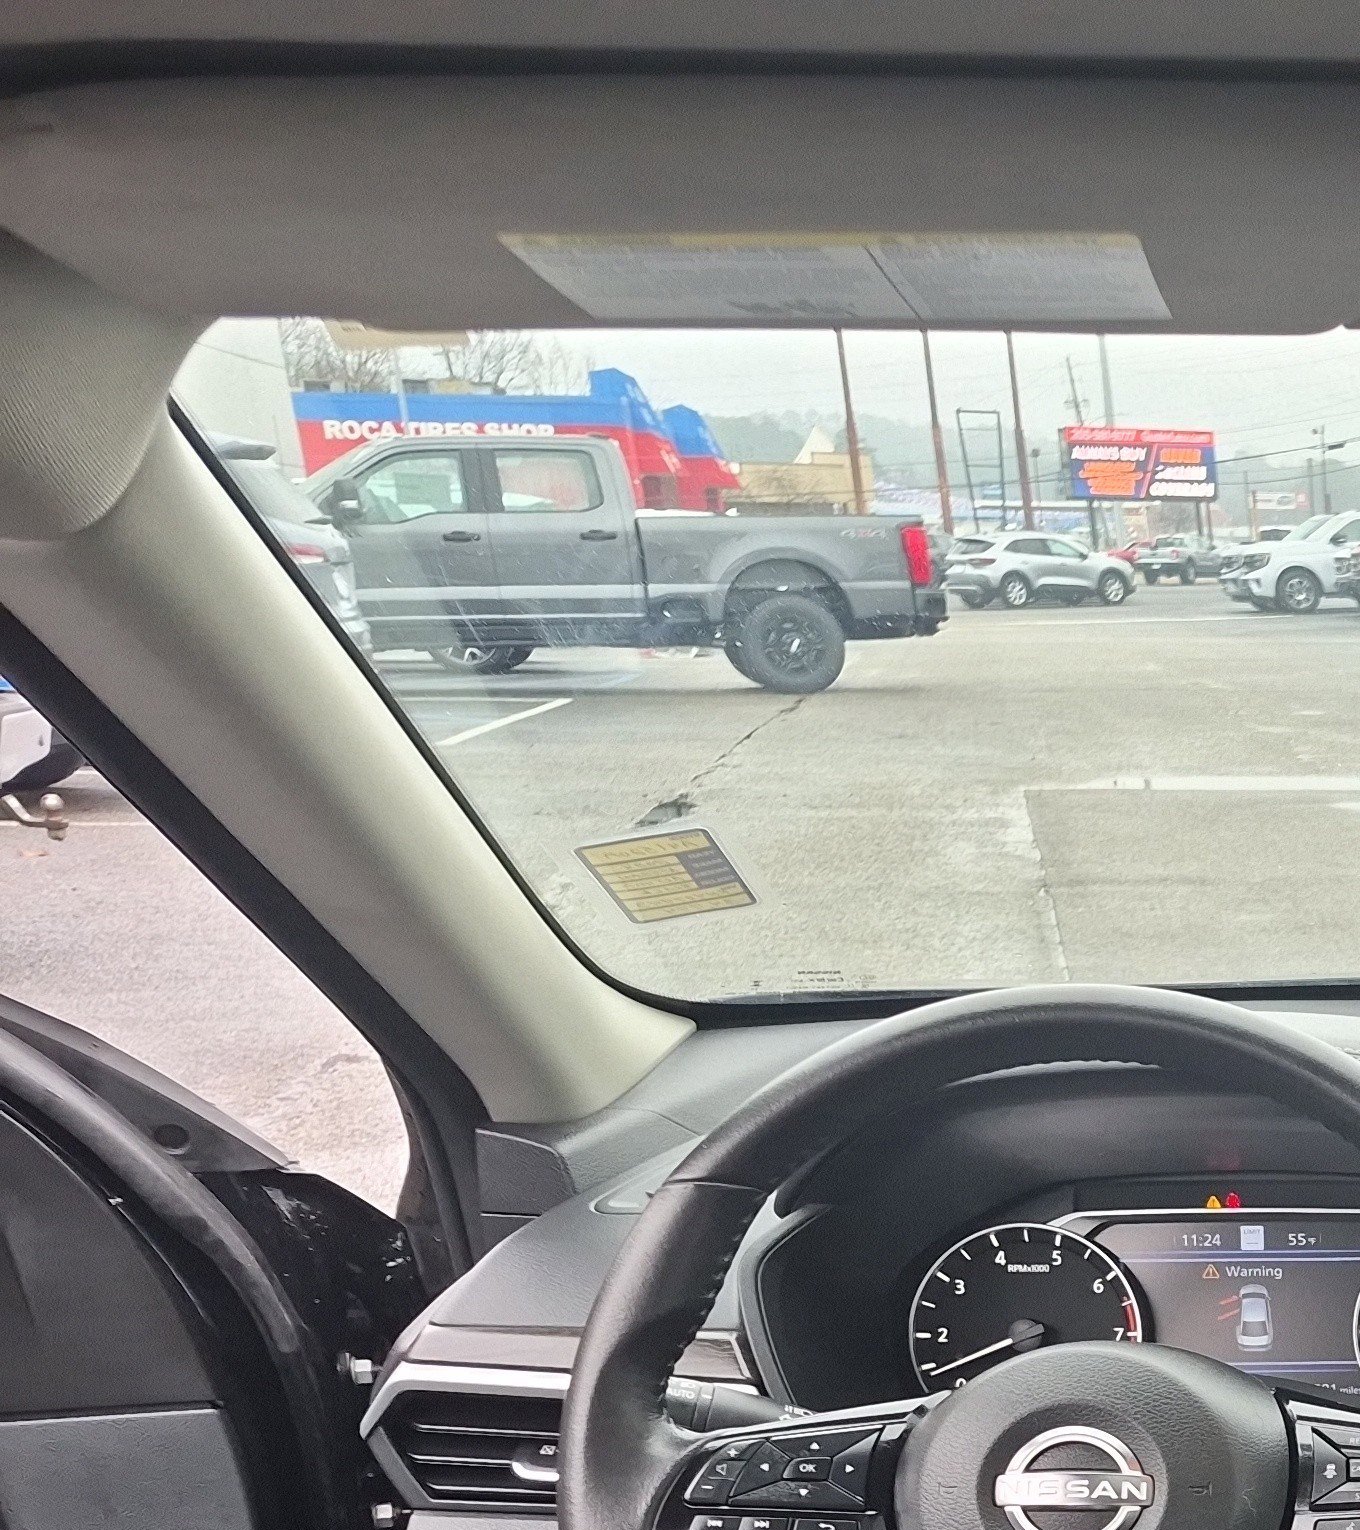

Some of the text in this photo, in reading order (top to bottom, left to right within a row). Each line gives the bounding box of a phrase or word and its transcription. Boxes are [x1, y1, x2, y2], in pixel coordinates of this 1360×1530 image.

[322, 420, 399, 439] ROCA
[1182, 1233, 1222, 1247] 11:24
[995, 1250, 1007, 1266] 4
[1051, 1250, 1062, 1266] 5
[1226, 1266, 1283, 1279] Warning
[954, 1279, 966, 1294] 3
[1093, 1278, 1104, 1294] 6
[937, 1328, 949, 1343] 2
[1113, 1327, 1125, 1342] 7
[667, 1387, 695, 1399] AUTO
[799, 1463, 817, 1473] OK
[1000, 1479, 1148, 1501] NISSAN
